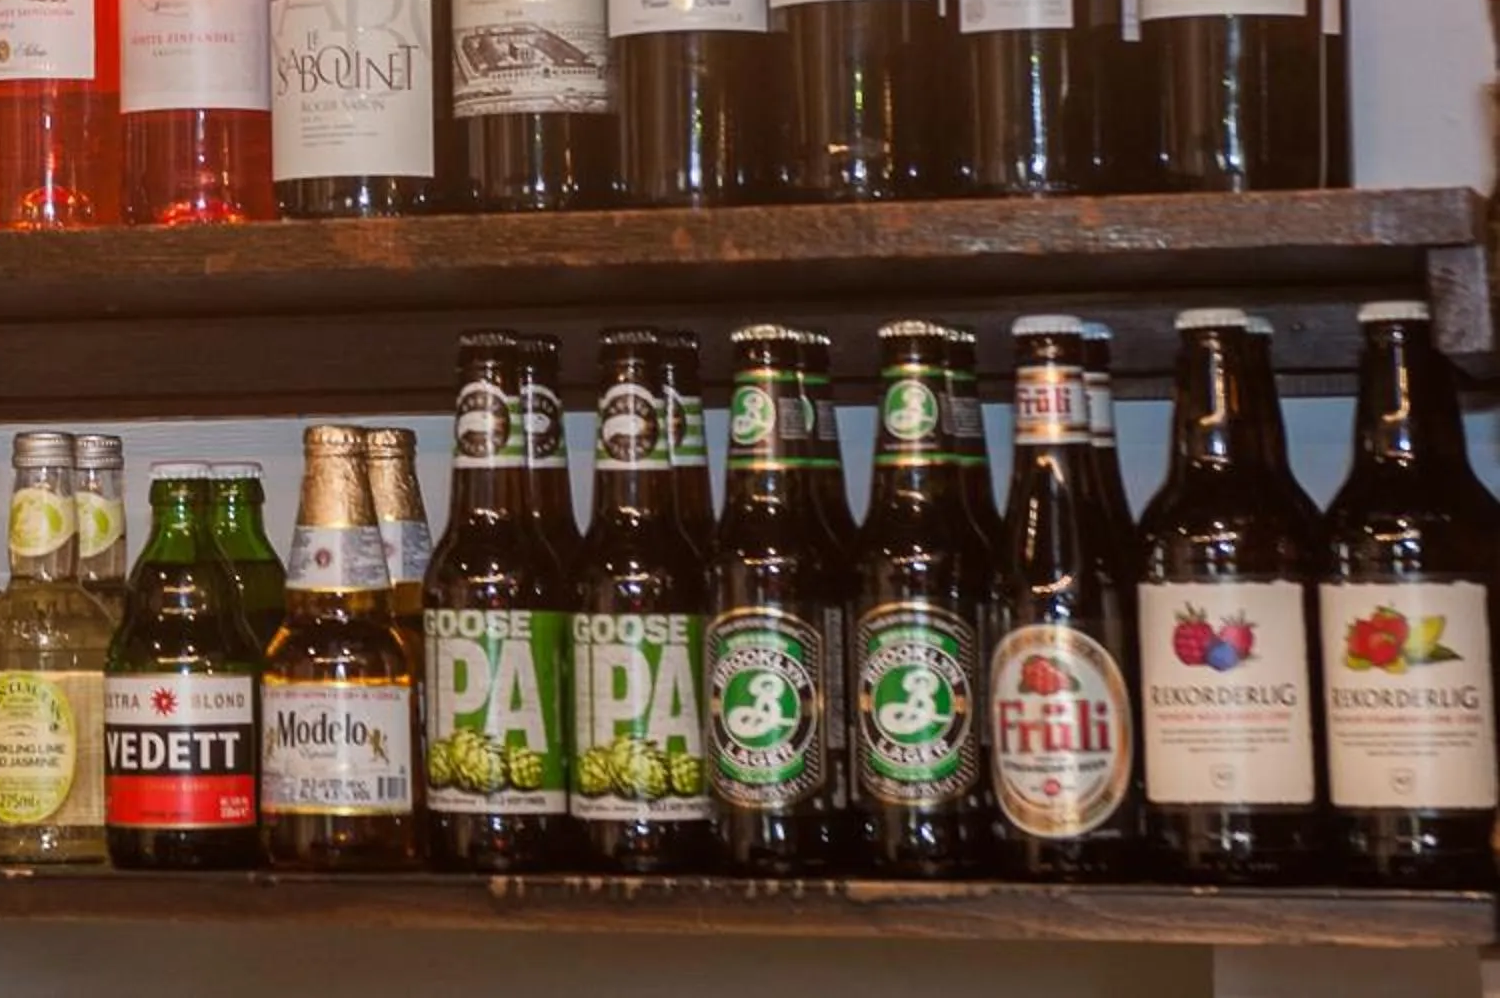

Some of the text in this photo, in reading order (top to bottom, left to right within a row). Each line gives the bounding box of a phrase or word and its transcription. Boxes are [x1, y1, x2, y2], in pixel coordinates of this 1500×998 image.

[424, 609, 532, 639] GOOSE
[572, 613, 690, 645] GOOSE
[277, 710, 368, 748] Modelo
[106, 730, 241, 771] VEDETT
[724, 740, 796, 768] LAGER
[876, 737, 951, 766] LAGER
